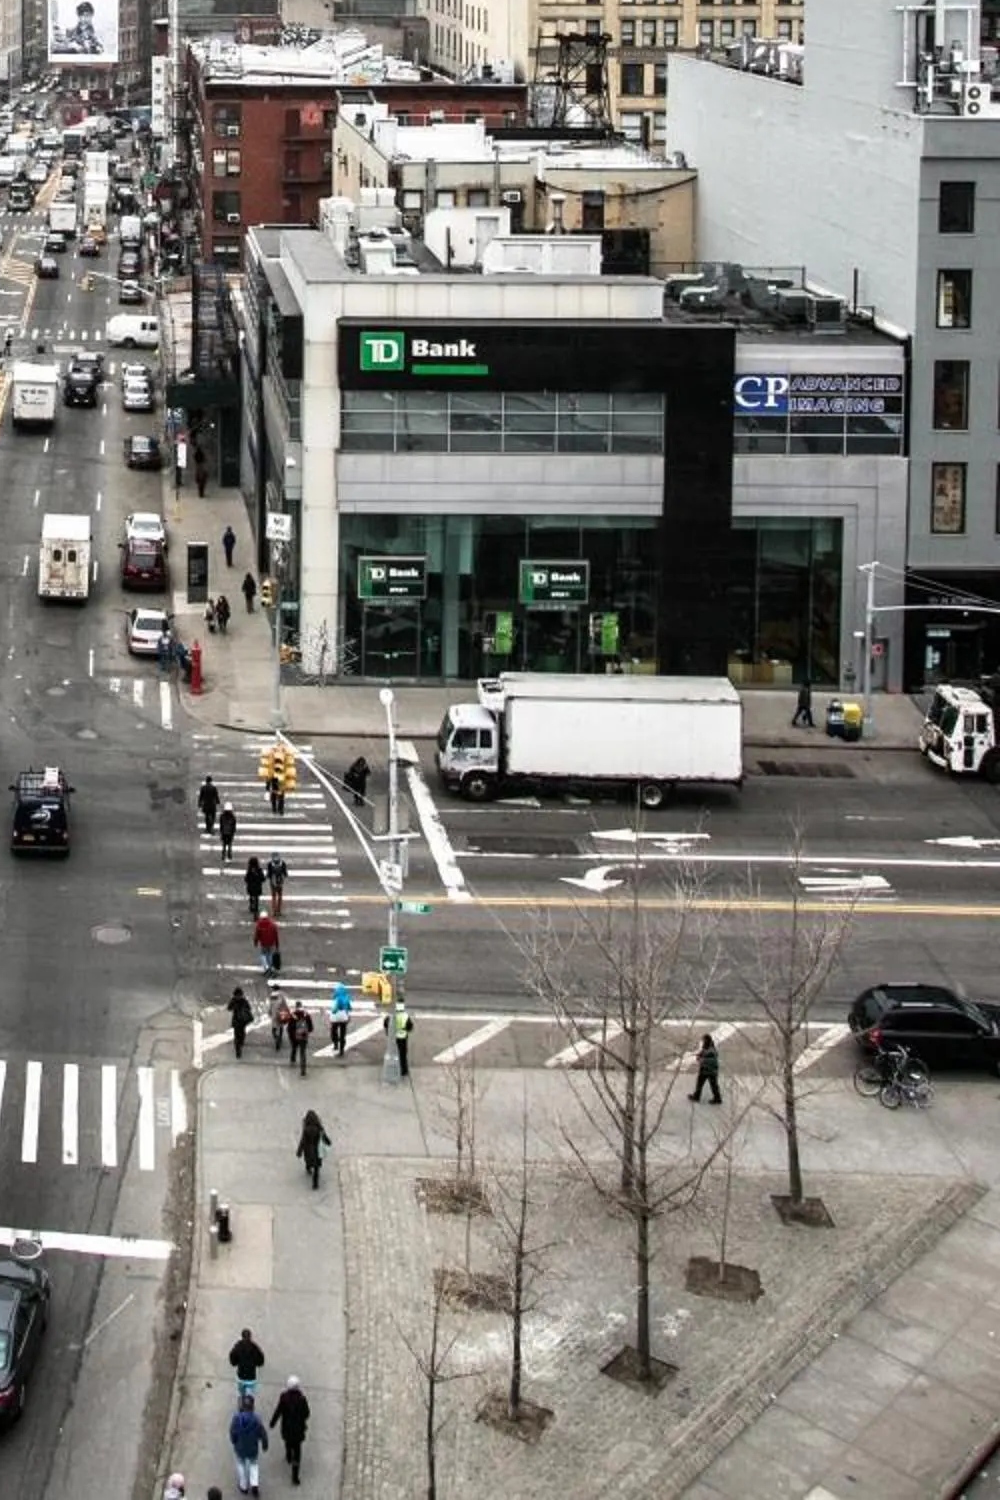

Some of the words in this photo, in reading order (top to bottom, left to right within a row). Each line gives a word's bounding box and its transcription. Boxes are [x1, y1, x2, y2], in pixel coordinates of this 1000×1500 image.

[364, 338, 400, 364] TD
[411, 338, 477, 357] Bank
[791, 376, 900, 391] ADVANCED
[734, 375, 789, 408] CP
[790, 397, 885, 413] IMAGING
[368, 567, 385, 579] TD
[389, 567, 419, 577] Bank
[530, 572, 547, 585] TD
[551, 572, 581, 582] Bank
